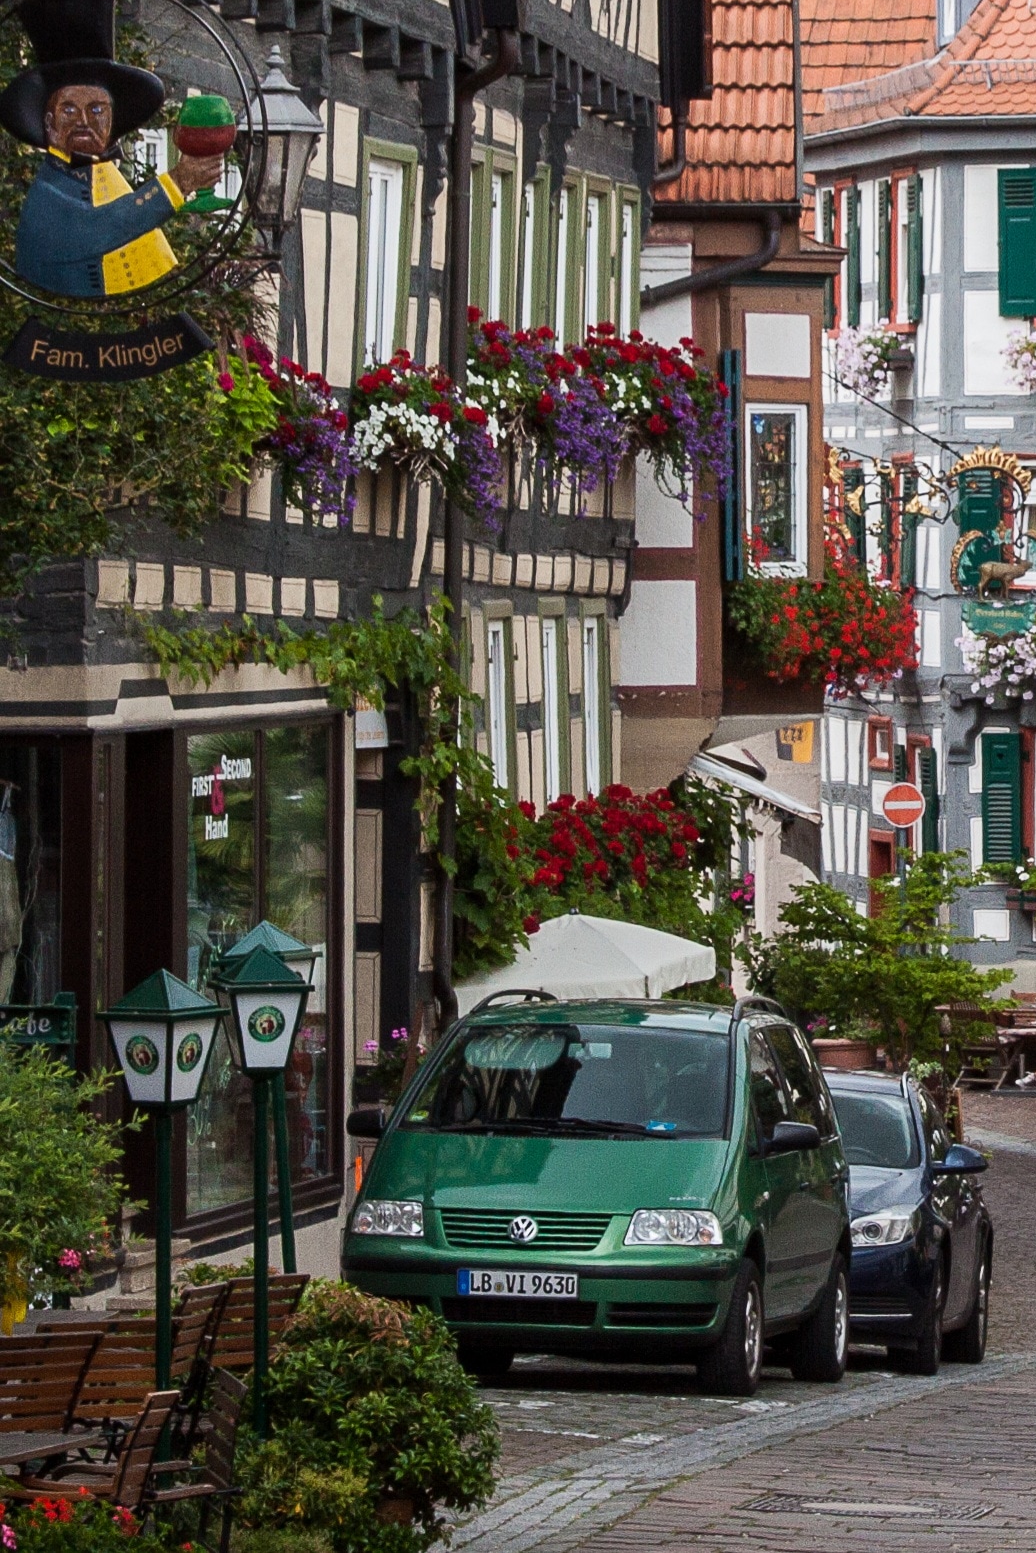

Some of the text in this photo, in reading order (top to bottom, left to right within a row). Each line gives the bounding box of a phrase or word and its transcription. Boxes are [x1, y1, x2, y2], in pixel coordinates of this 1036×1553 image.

[30, 333, 184, 369] Fam. Klingler
[191, 774, 215, 797] FIRST
[205, 813, 229, 841] Hand
[470, 1273, 576, 1295] LB VI 9630
